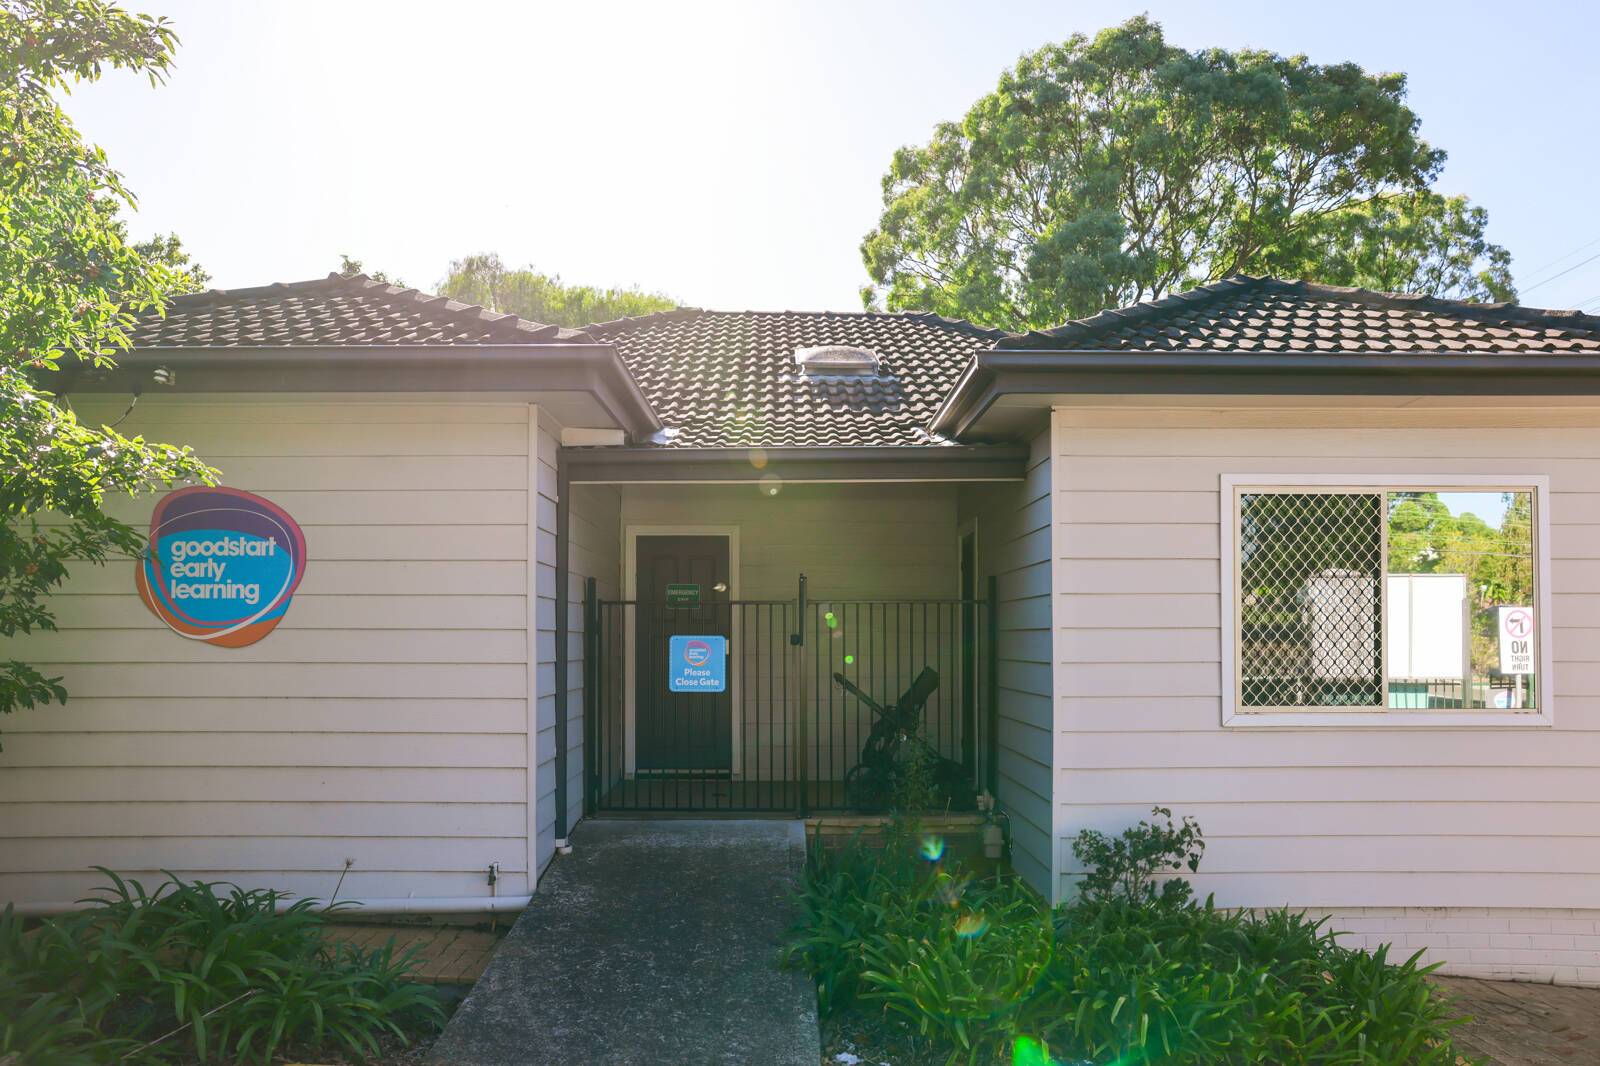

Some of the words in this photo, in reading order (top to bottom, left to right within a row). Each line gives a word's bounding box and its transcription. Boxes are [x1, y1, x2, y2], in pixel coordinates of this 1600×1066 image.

[170, 536, 277, 562] goodstart
[170, 558, 226, 582] early
[170, 579, 260, 605] learning
[675, 678, 699, 686] Close
[699, 678, 720, 686] Gate
[684, 668, 711, 677] Please
